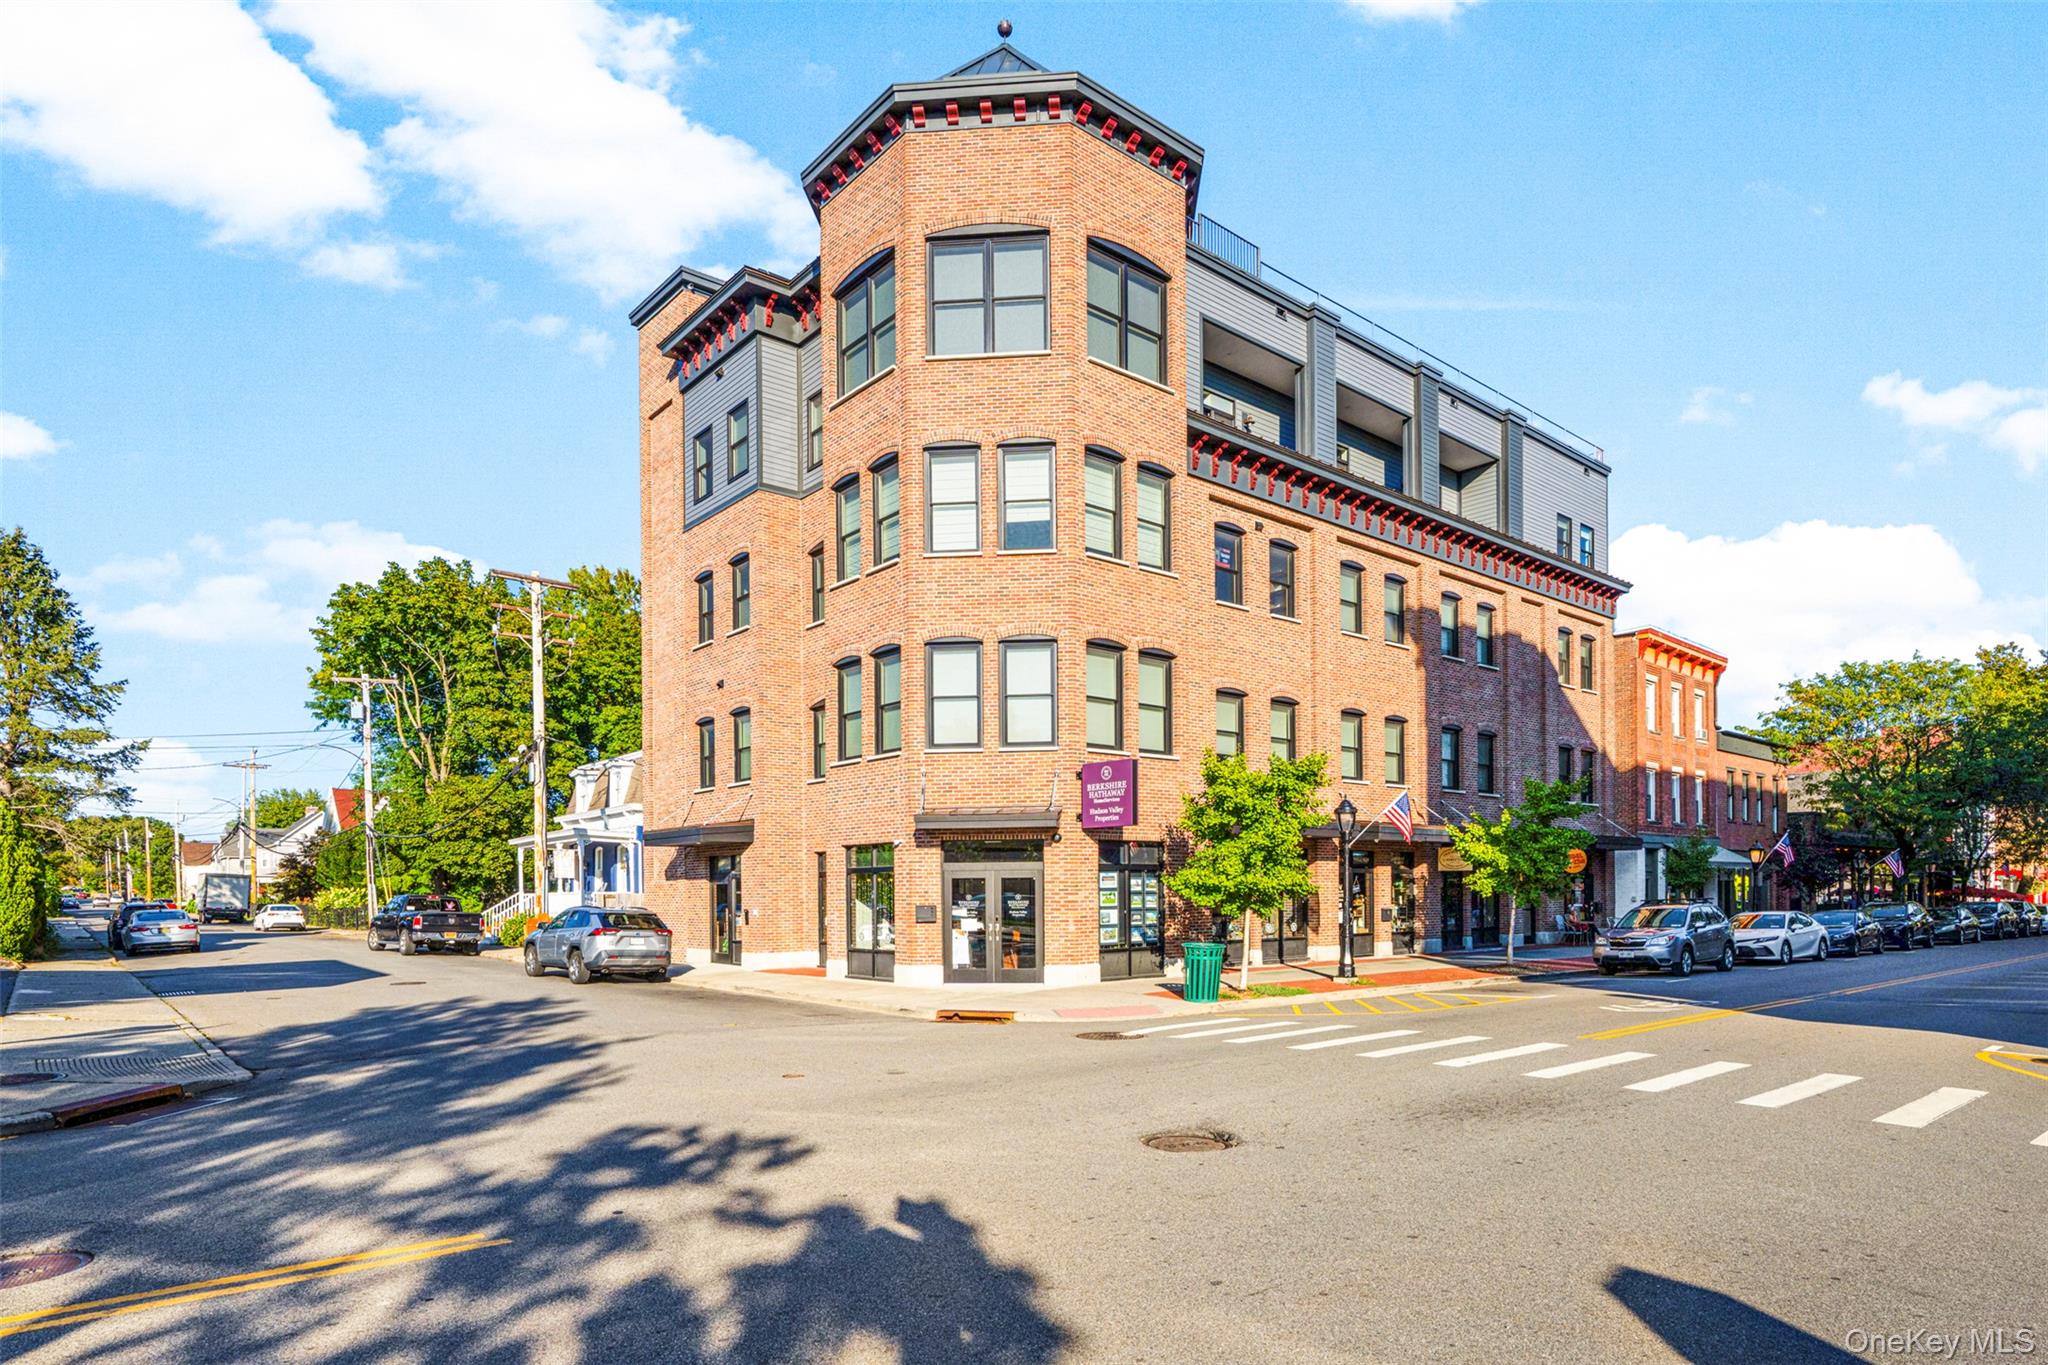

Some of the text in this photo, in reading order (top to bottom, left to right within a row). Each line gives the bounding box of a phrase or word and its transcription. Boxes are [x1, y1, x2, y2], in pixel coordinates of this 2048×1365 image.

[1087, 780, 1127, 791] BERKSHIRE
[1089, 788, 1125, 798] HATHAWAY
[1108, 806, 1123, 814] Valley
